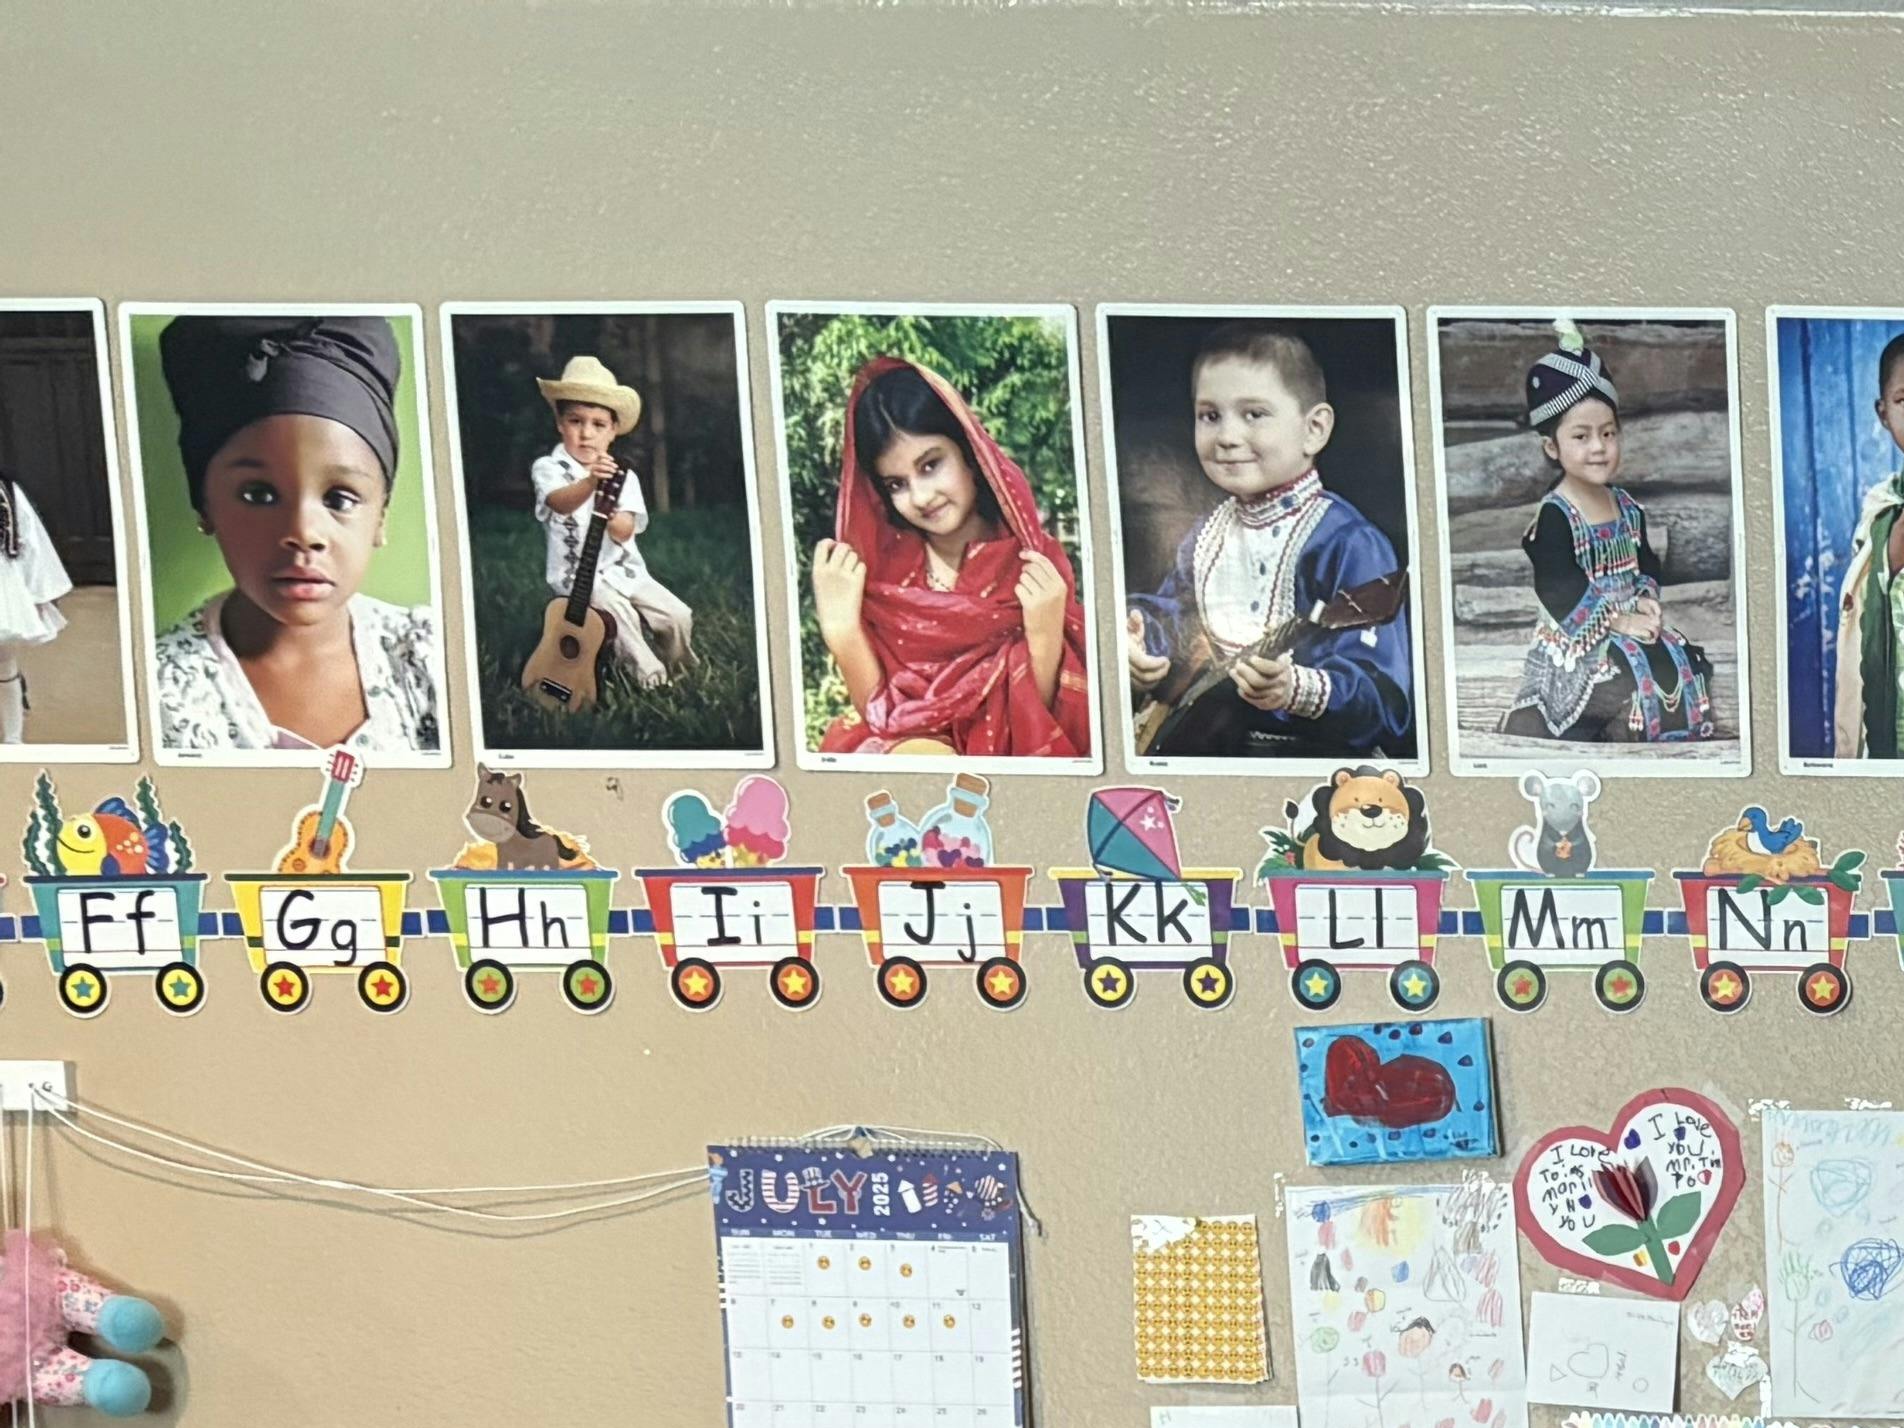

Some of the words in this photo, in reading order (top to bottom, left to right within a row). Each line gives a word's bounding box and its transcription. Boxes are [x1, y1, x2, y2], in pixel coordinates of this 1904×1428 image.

[81, 892, 159, 954] Ff
[277, 891, 359, 965] Gg
[482, 886, 571, 952] Hh
[705, 884, 764, 948] Ii
[911, 883, 972, 963] Jj
[1108, 885, 1192, 949] Kk
[1330, 888, 1384, 950] Ll
[1509, 889, 1609, 950] Mm
[1721, 889, 1806, 951] Nn
[726, 1167, 868, 1215] JULY
[871, 1172, 891, 1216] 2025
